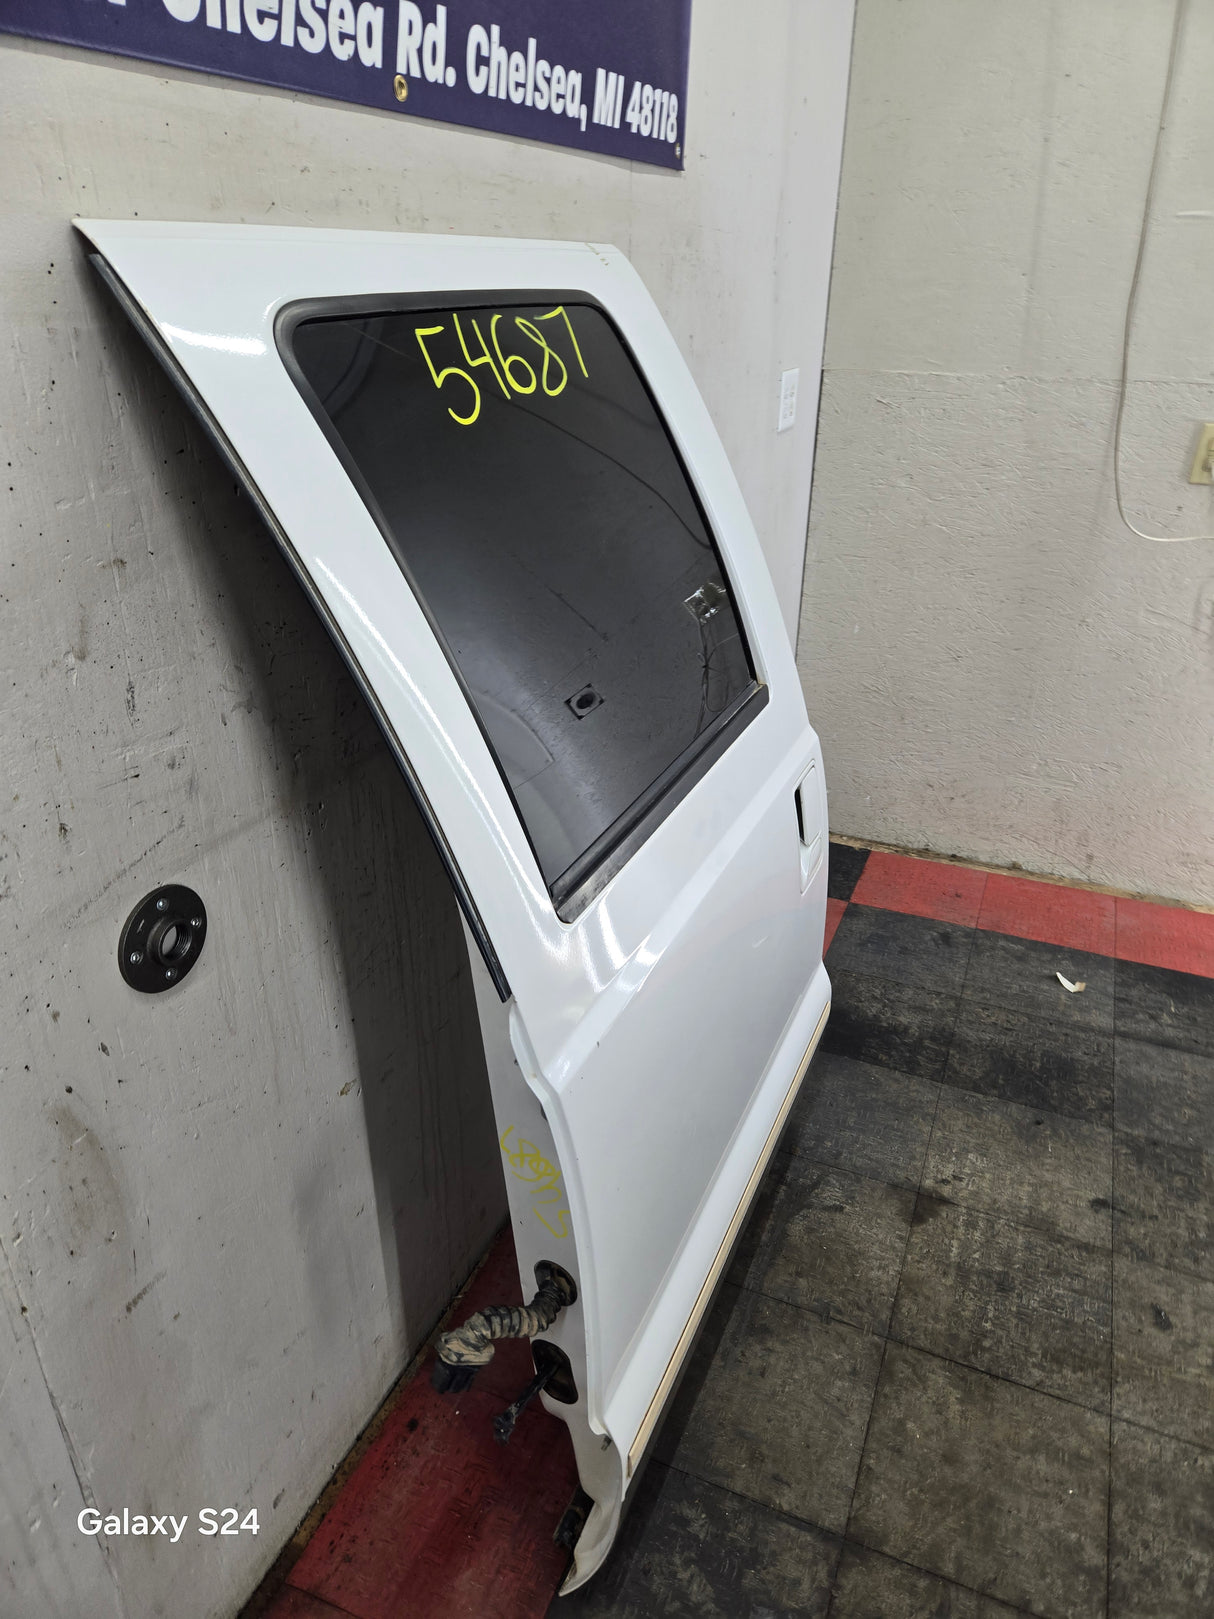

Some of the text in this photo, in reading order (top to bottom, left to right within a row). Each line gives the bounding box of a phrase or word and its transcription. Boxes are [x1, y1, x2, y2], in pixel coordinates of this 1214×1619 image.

[396, 0, 456, 87] Rd.
[466, 23, 588, 132] Chelsea,
[592, 67, 625, 129] MI
[625, 80, 678, 144] 48118
[414, 305, 589, 426] 54687
